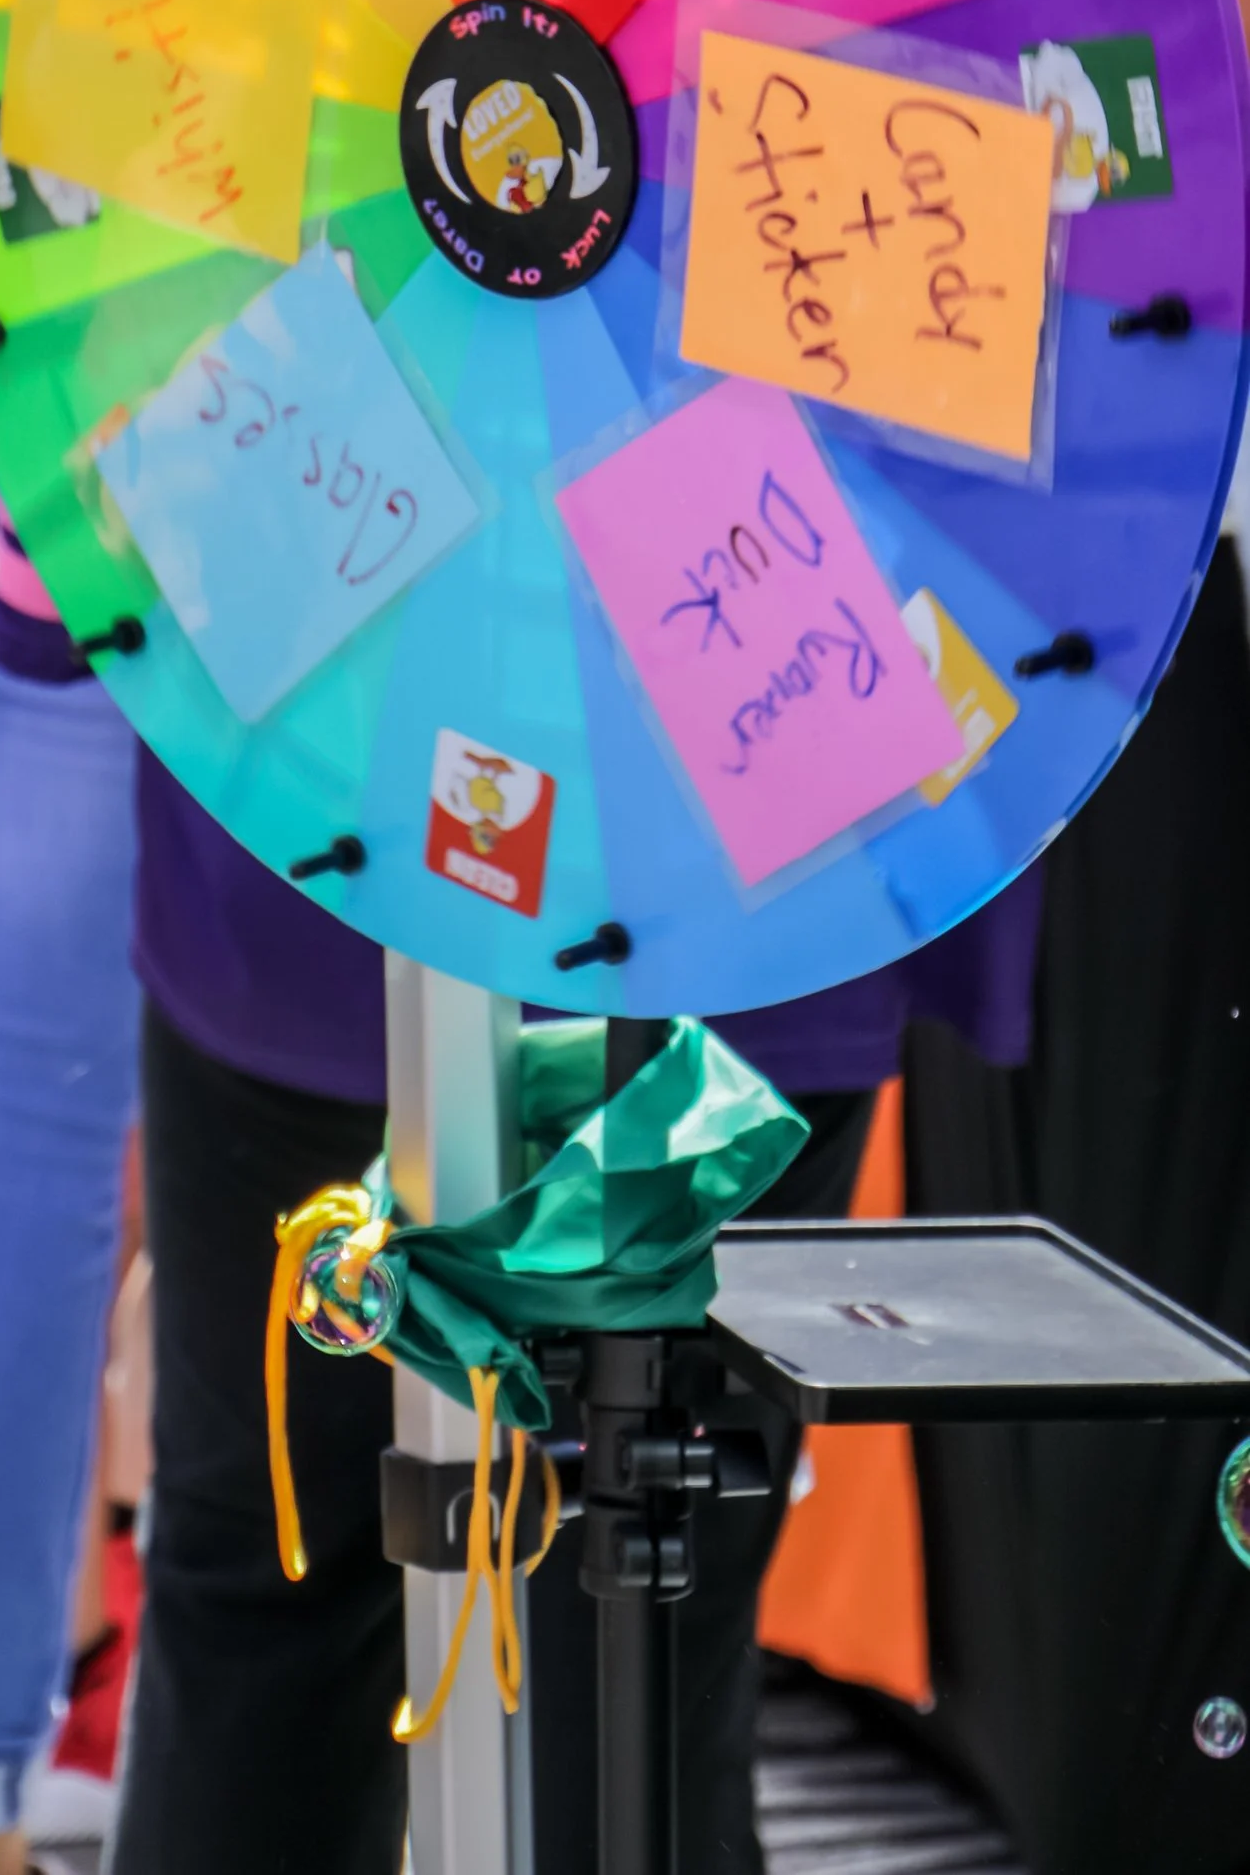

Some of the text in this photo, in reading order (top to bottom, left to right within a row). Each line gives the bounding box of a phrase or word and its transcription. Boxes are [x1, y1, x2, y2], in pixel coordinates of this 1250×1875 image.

[449, 3, 559, 39] Spin It!
[461, 81, 523, 143] LOVED
[559, 208, 612, 270] Luck
[707, 73, 850, 394] Sticker
[841, 189, 895, 251] +
[884, 98, 1007, 352] Candy
[506, 267, 542, 286] or
[660, 469, 826, 654] Duck
